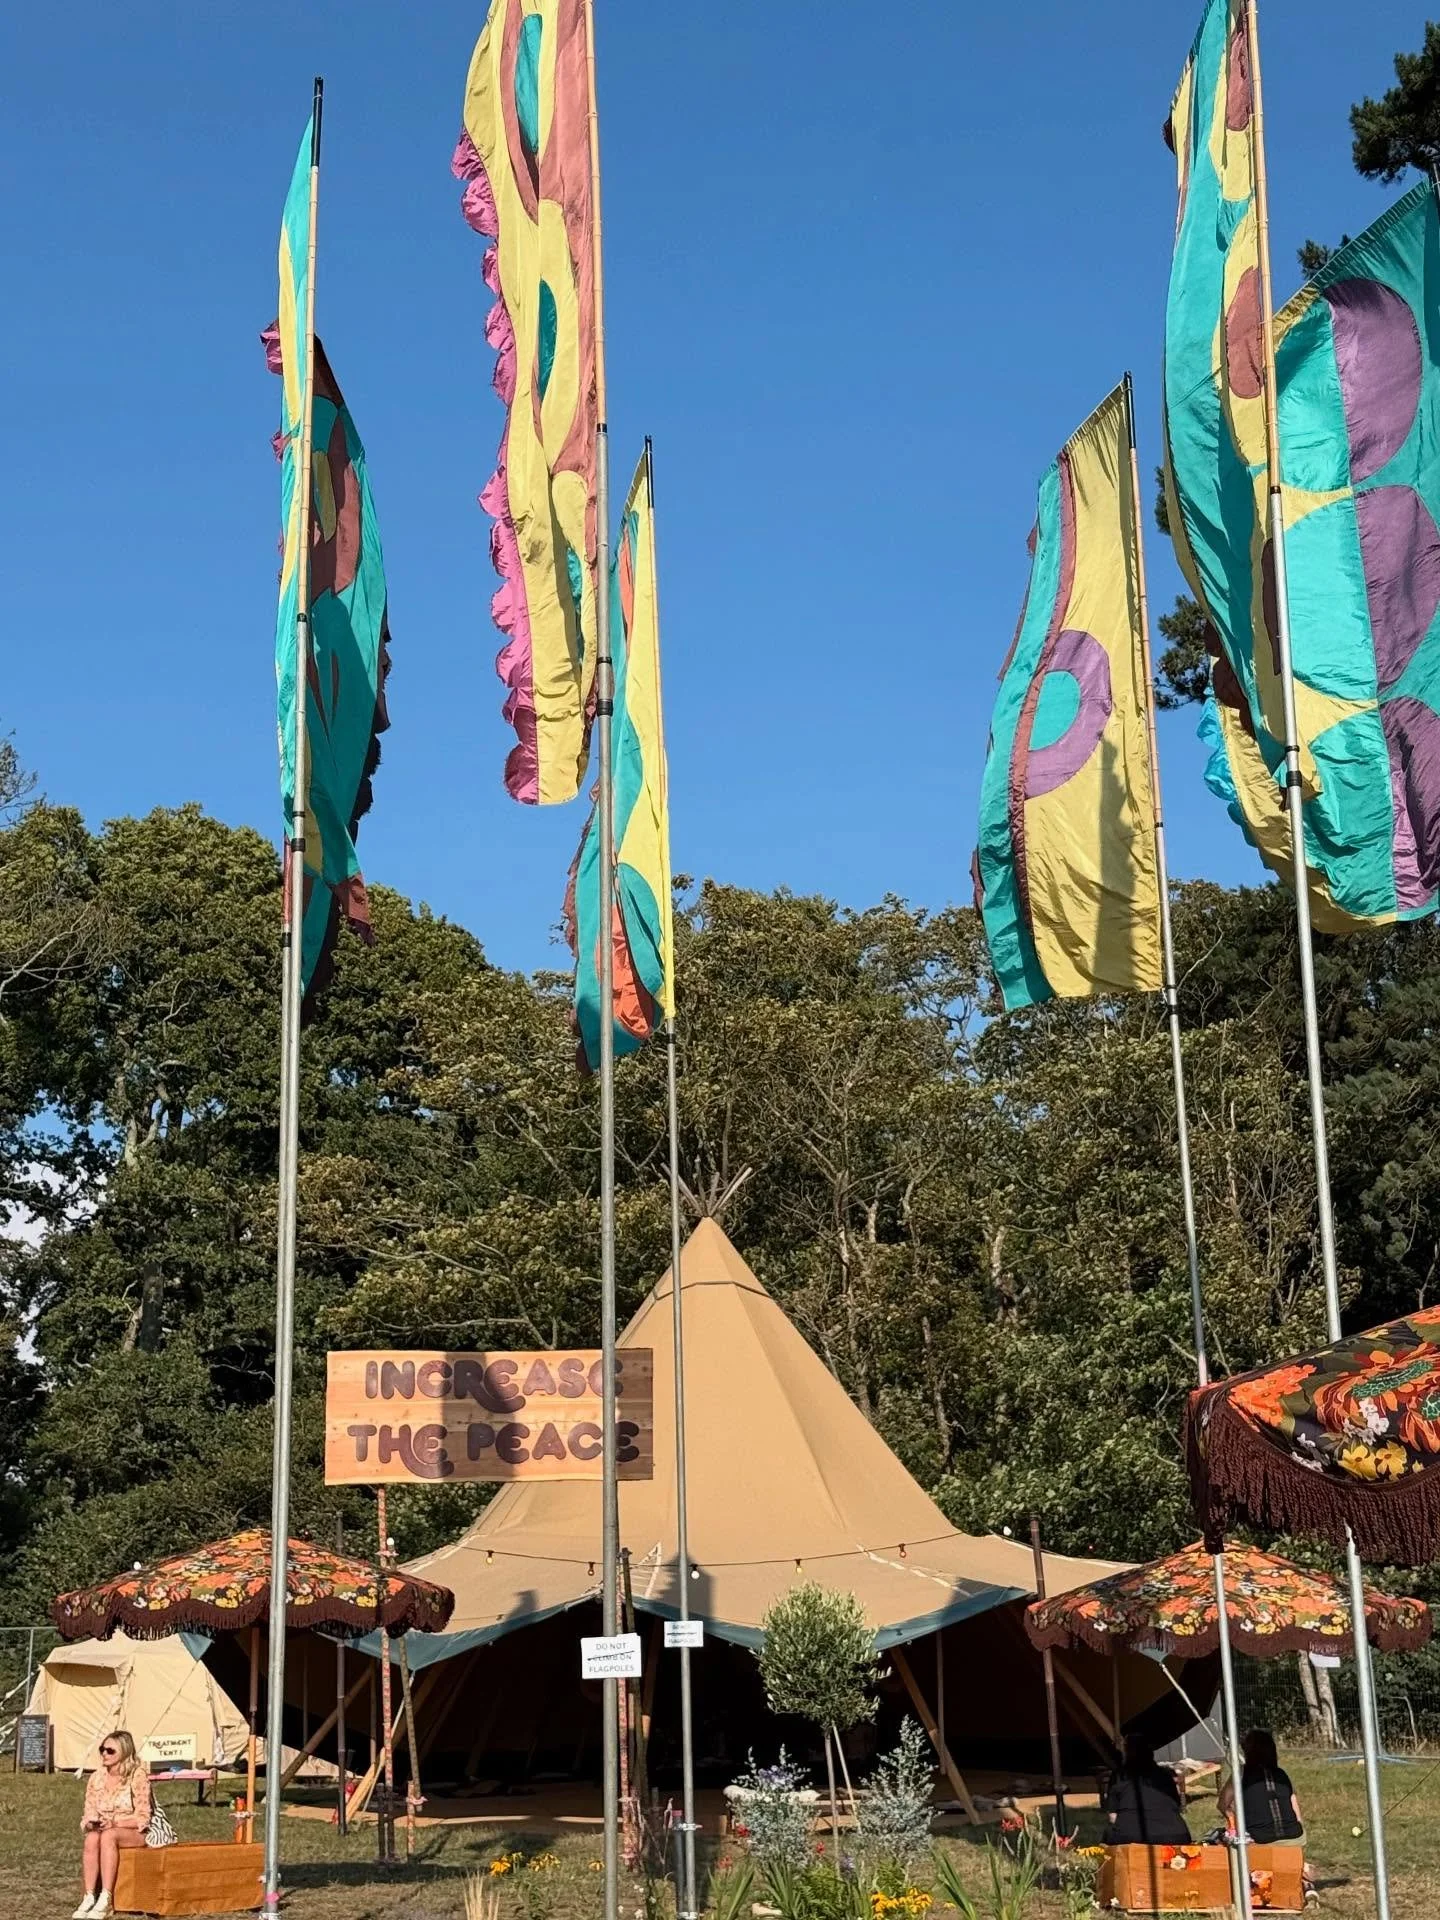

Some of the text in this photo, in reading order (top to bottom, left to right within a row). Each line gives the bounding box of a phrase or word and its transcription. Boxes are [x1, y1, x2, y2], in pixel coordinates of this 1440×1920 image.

[365, 1358, 624, 1414] INCREASE
[347, 1421, 640, 1479] THE PEACE
[589, 1665, 634, 1673] FLAGPOLES
[148, 1739, 191, 1749] TREATMENT
